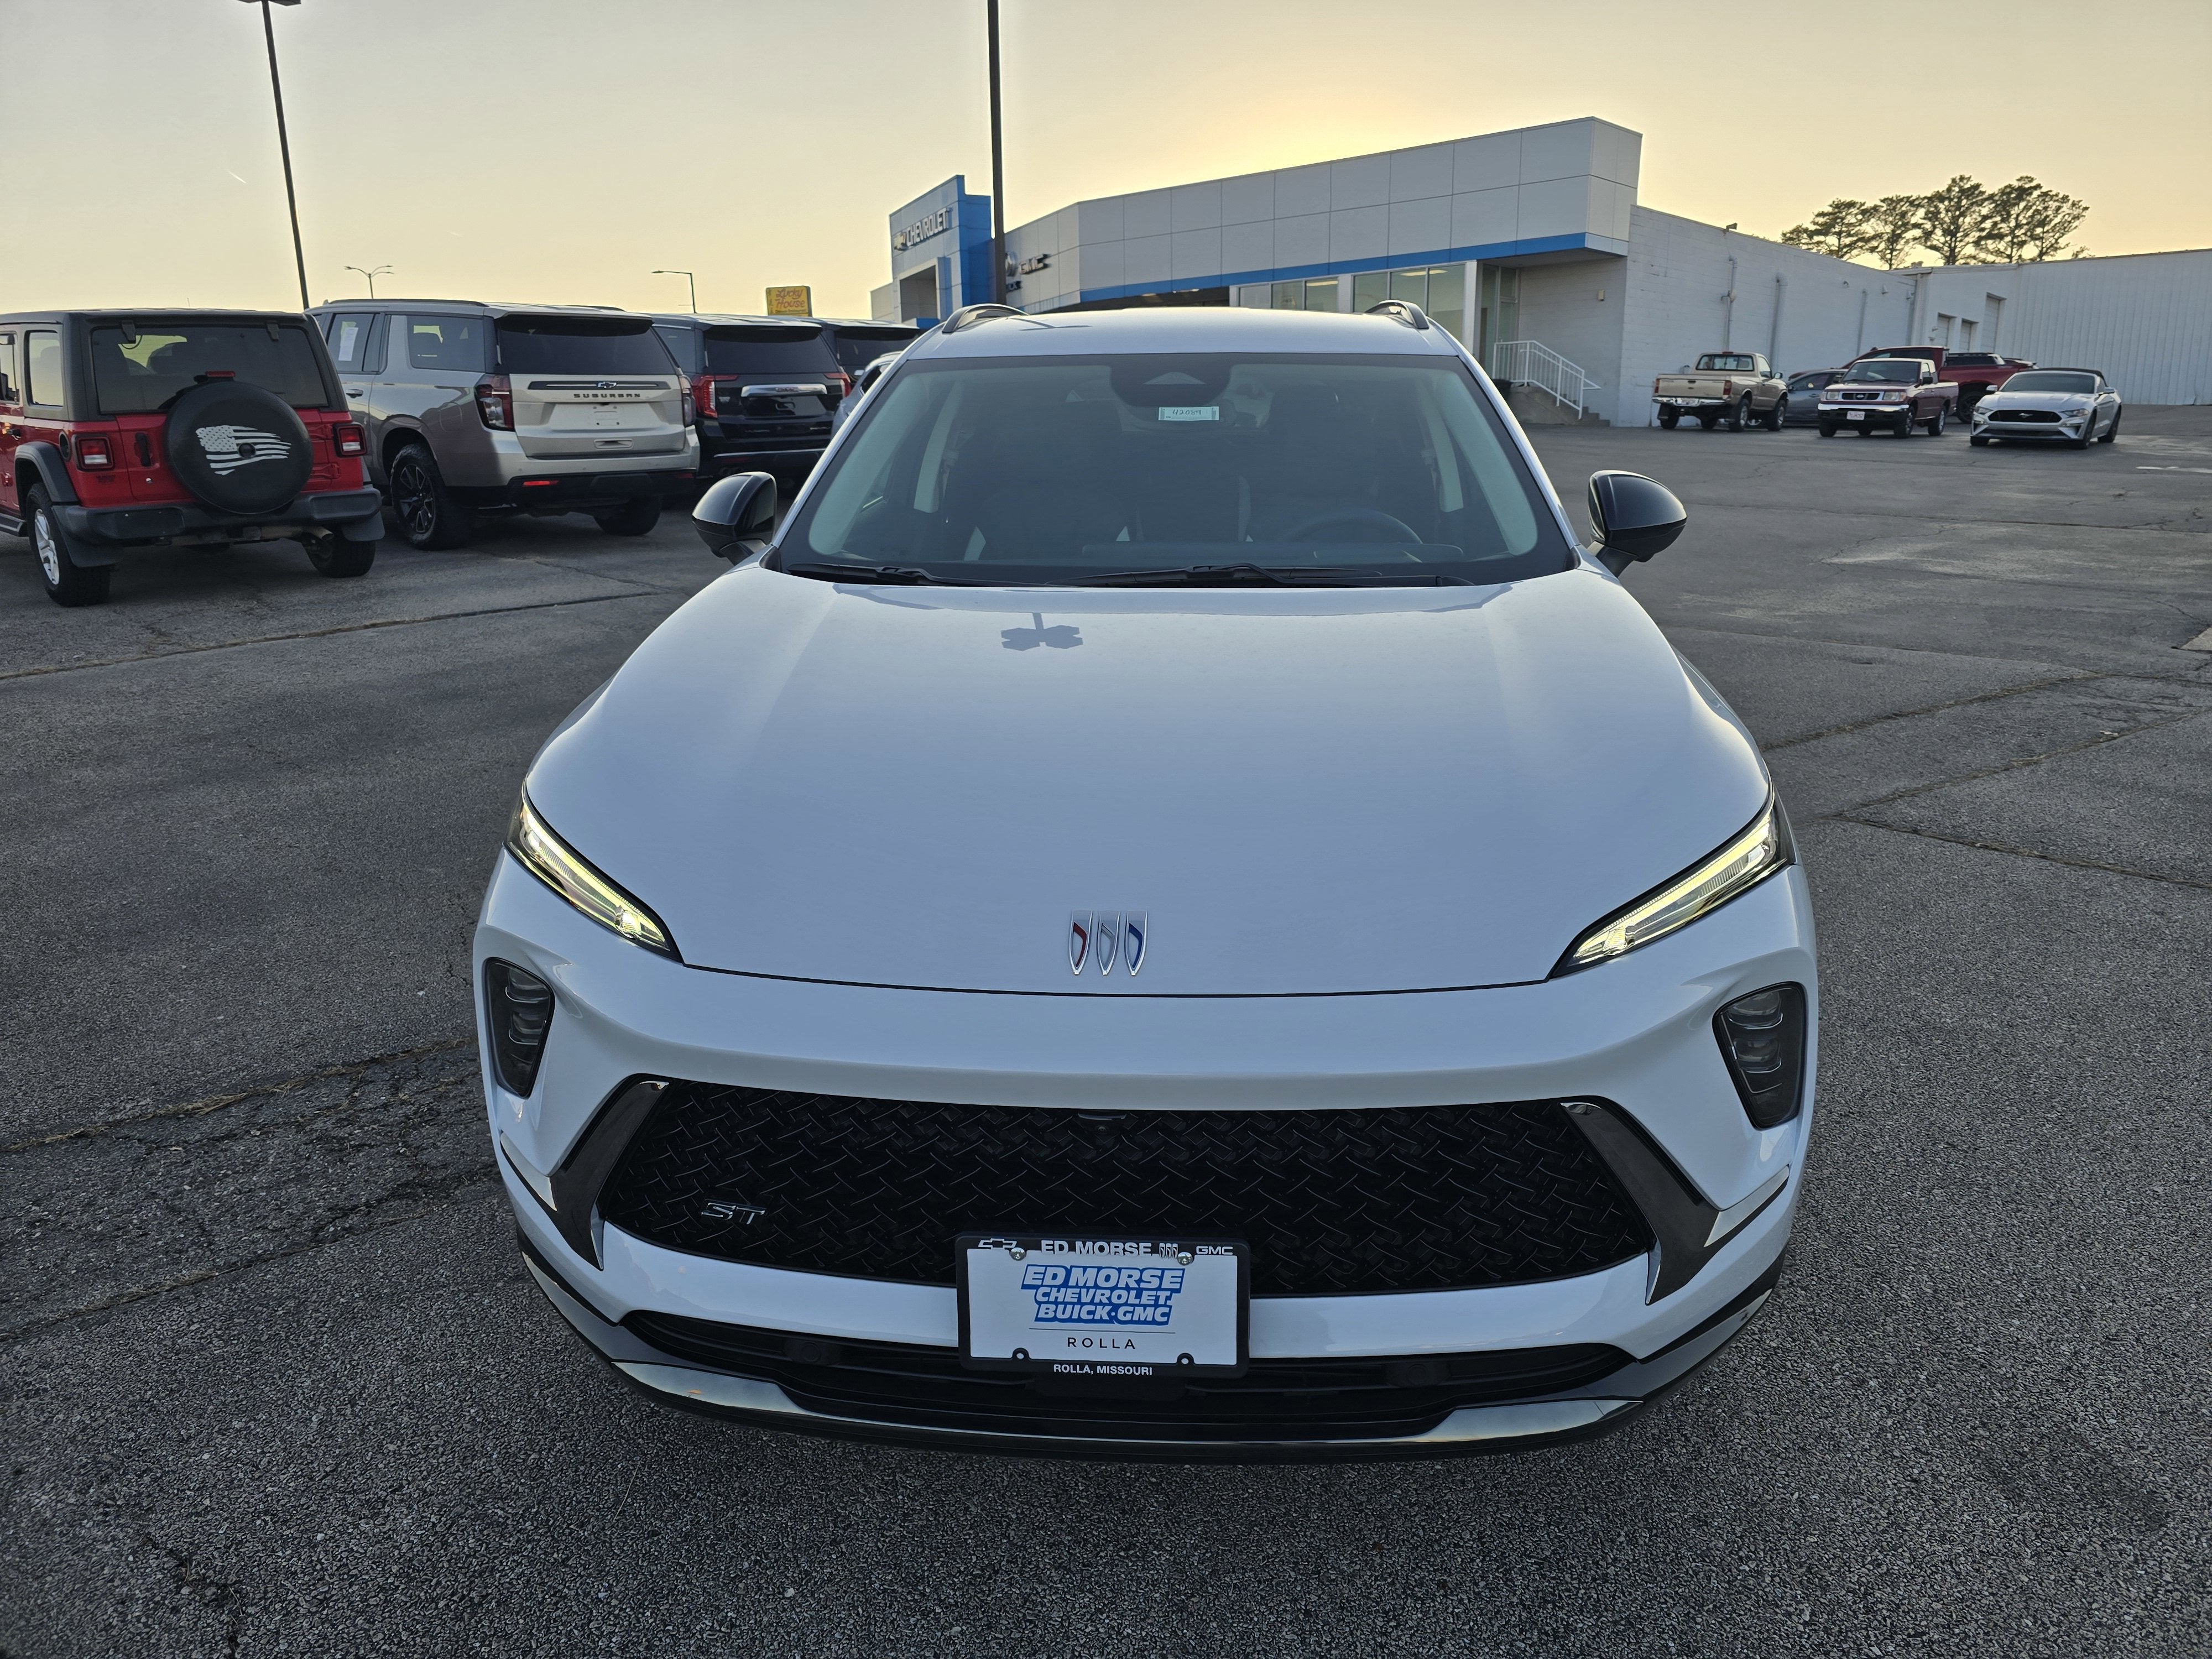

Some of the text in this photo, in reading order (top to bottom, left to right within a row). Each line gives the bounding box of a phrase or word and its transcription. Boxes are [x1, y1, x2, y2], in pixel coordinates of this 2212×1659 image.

[906, 207, 947, 247] CHEVROLET
[1019, 254, 1045, 274] GMC
[776, 288, 804, 300] Lucky
[775, 299, 806, 310] House
[1041, 1240, 1152, 1256] ED MORSE
[1196, 1245, 1233, 1255] GMC
[1023, 1265, 1183, 1289] ED MORSE
[1036, 1287, 1171, 1305] CHEVROLET
[1067, 1337, 1136, 1350] ROLLA
[1053, 1364, 1153, 1375] ROLLA, MISSOURI
